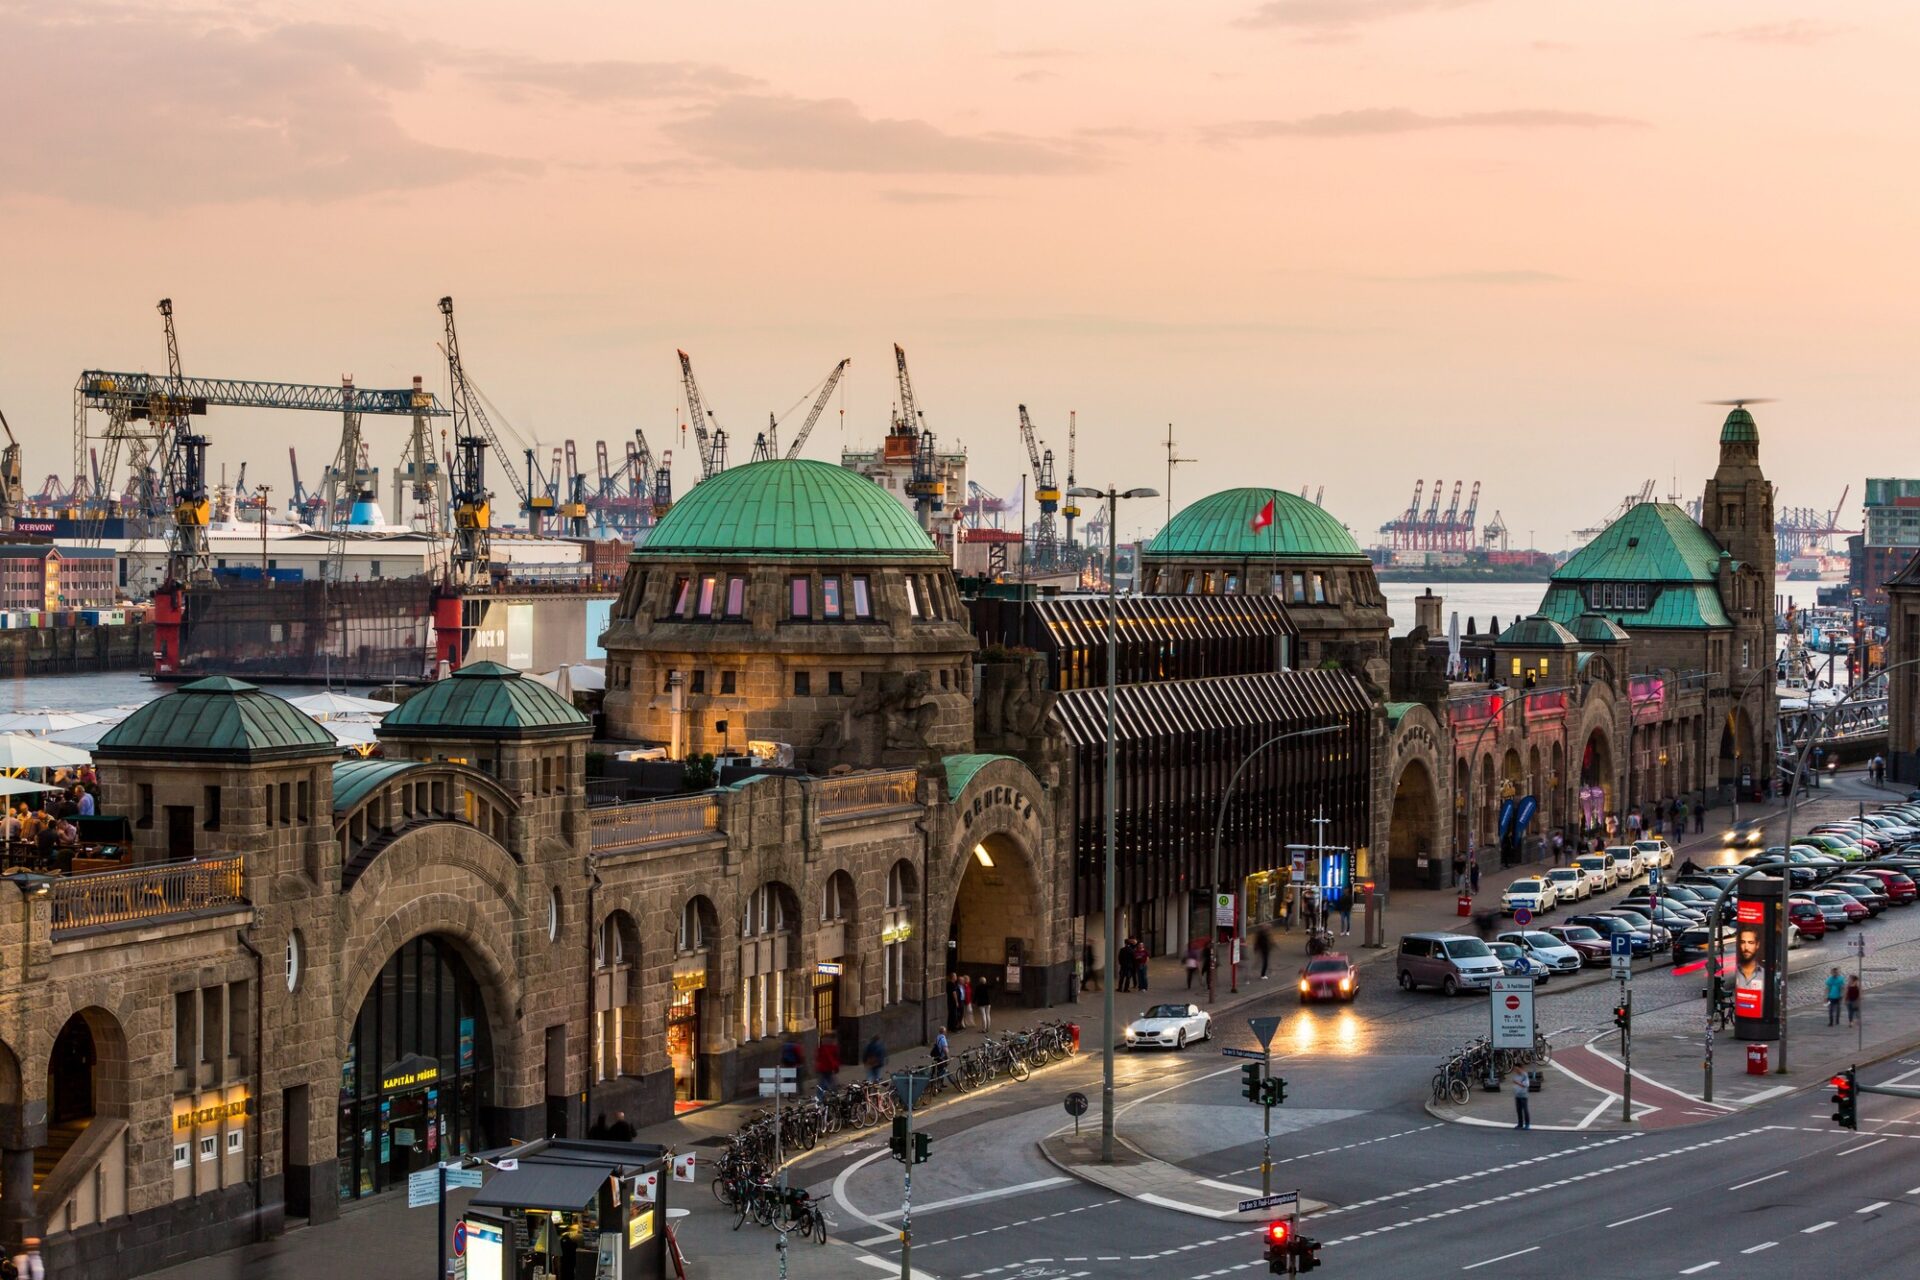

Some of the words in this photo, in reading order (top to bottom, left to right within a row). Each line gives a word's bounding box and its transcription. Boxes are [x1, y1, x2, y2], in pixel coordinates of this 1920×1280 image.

[19, 523, 52, 531] XERVON
[476, 630, 495, 648] DOCK
[496, 629, 505, 647] 10
[1616, 936, 1626, 952] P
[383, 1073, 415, 1089] KAPITÄN
